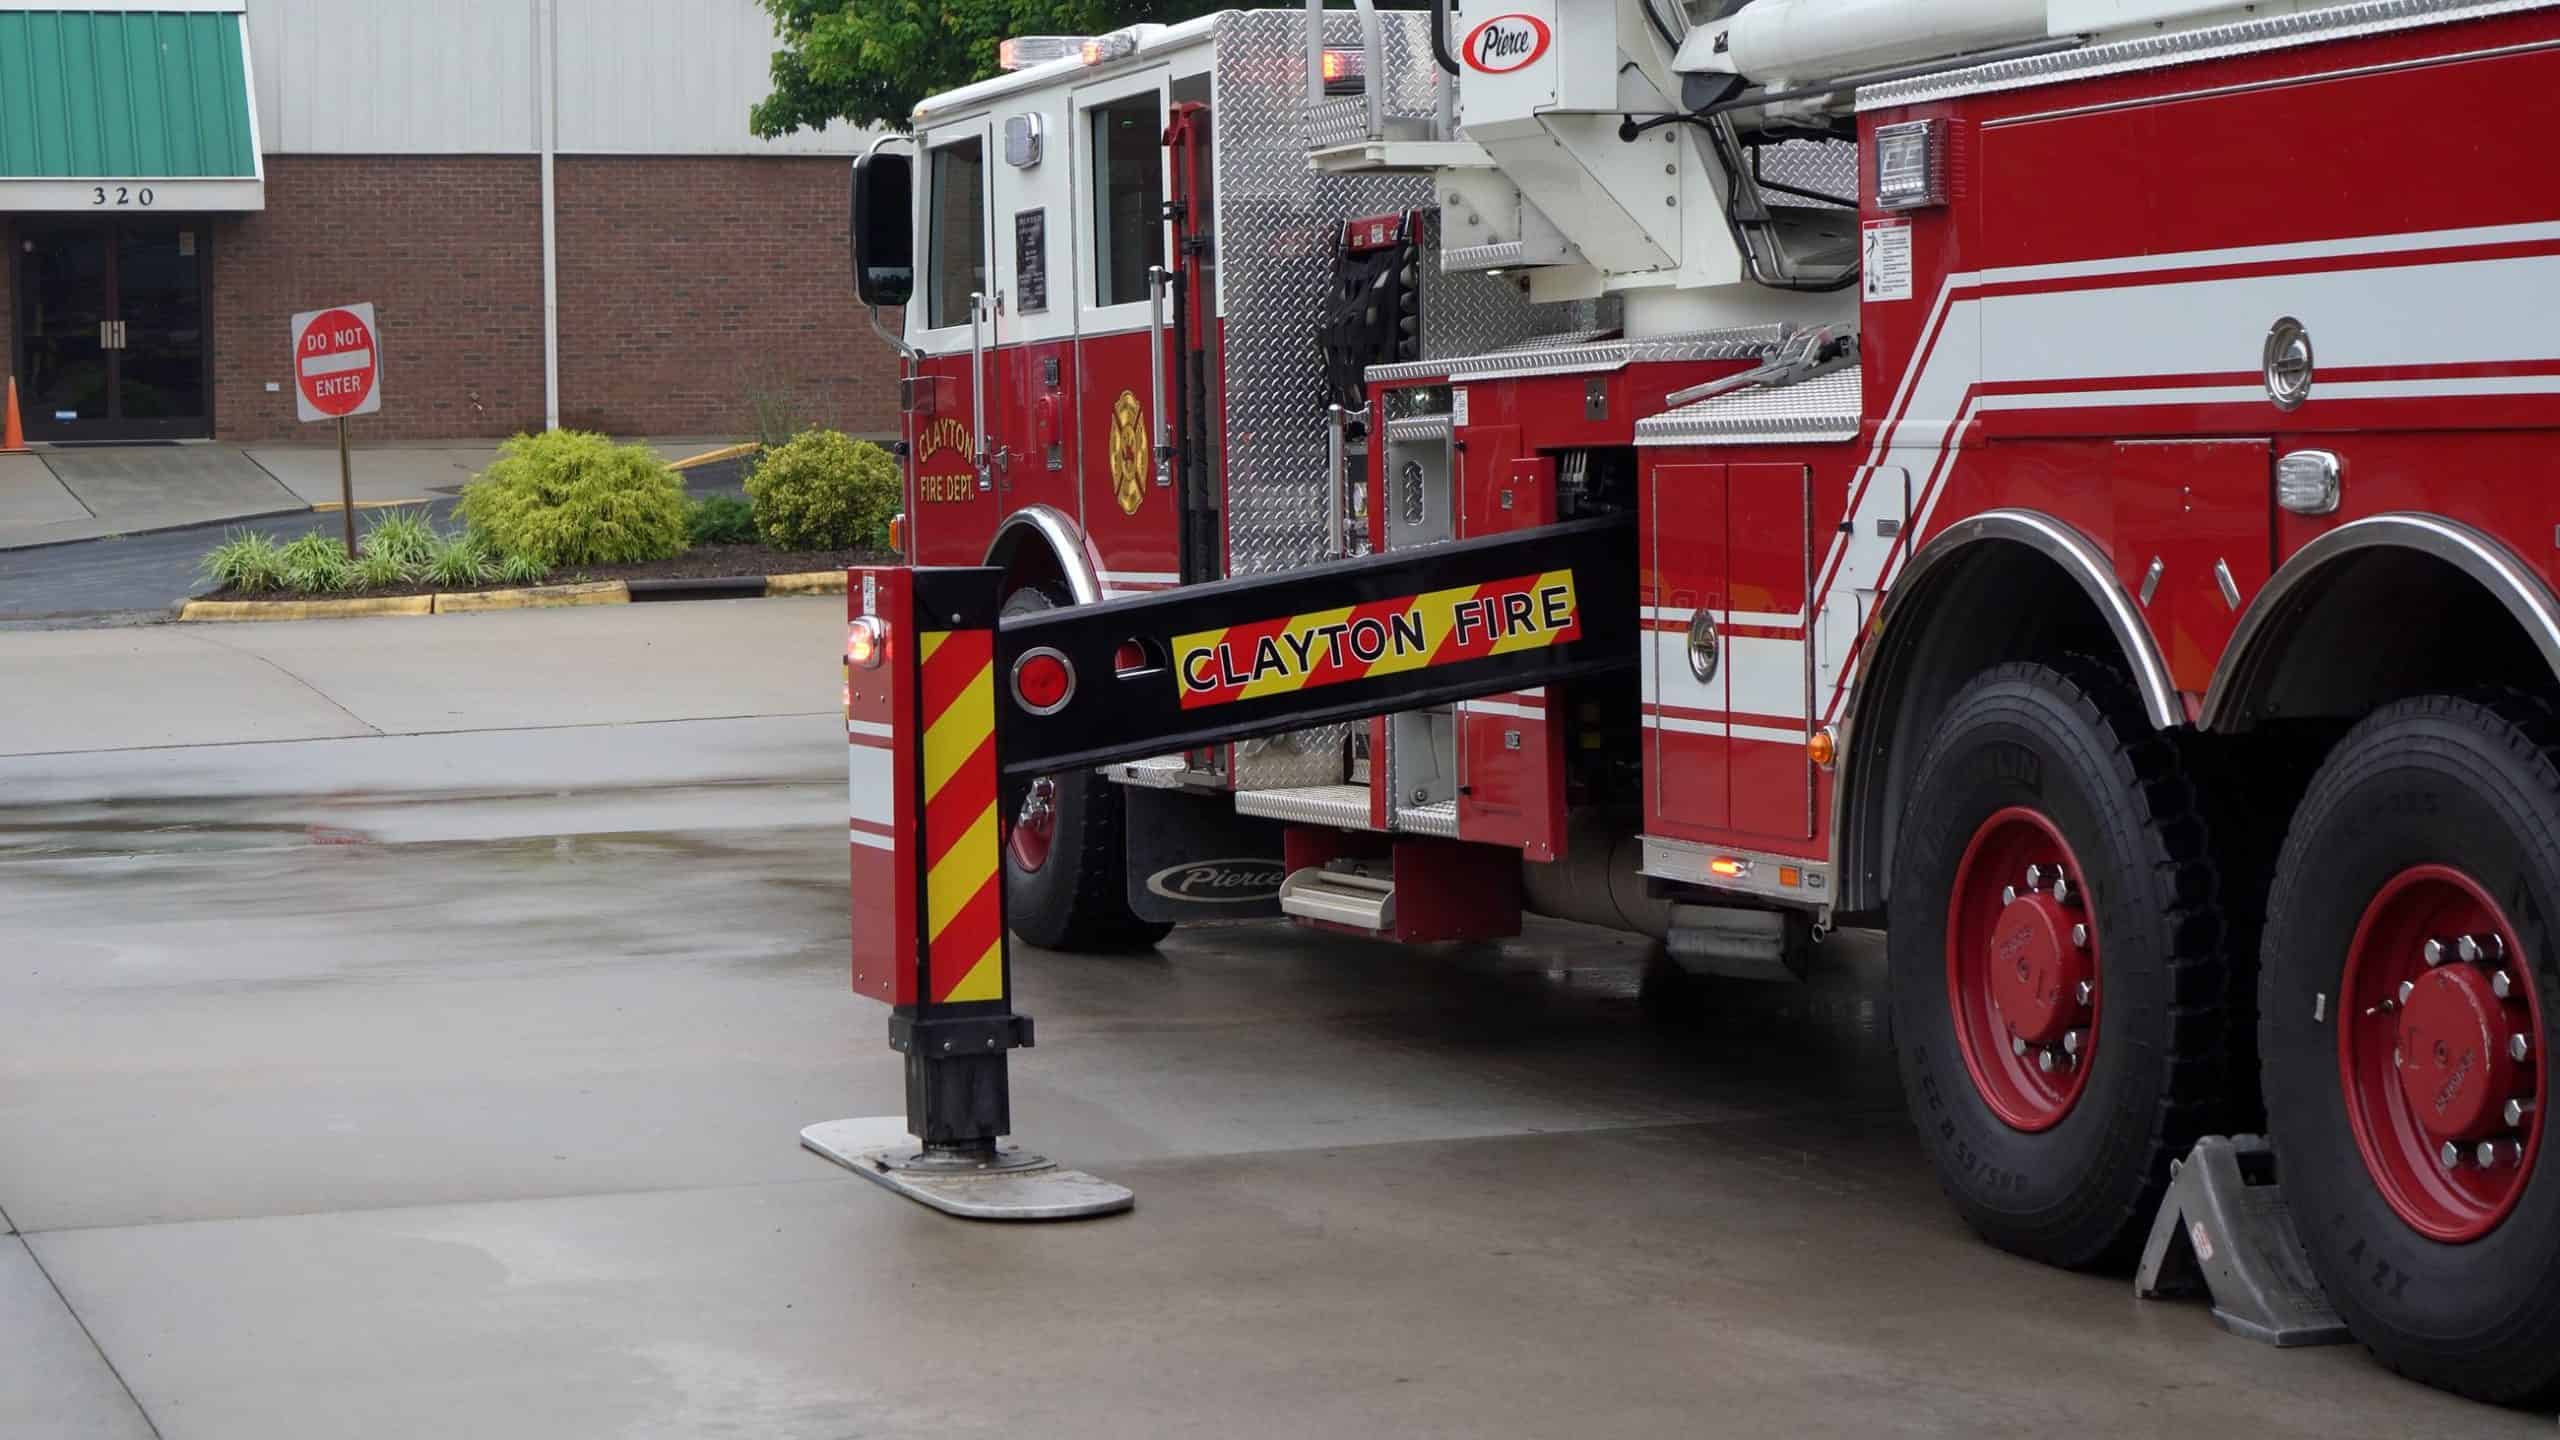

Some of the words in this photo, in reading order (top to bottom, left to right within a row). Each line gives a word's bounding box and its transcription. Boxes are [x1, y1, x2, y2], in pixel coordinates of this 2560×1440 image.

[1481, 25, 1529, 65] Pierce
[93, 187, 154, 206] 320
[307, 333, 327, 351] DO
[335, 327, 362, 347] NOT
[315, 375, 361, 398] ENTER
[919, 417, 974, 465] CLAYTON
[920, 475, 943, 502] FIRE
[946, 474, 975, 501] DEPT.
[1182, 610, 1427, 693] CLAYTON
[1454, 585, 1573, 647] FIRE
[1179, 867, 1284, 893] Pierce
